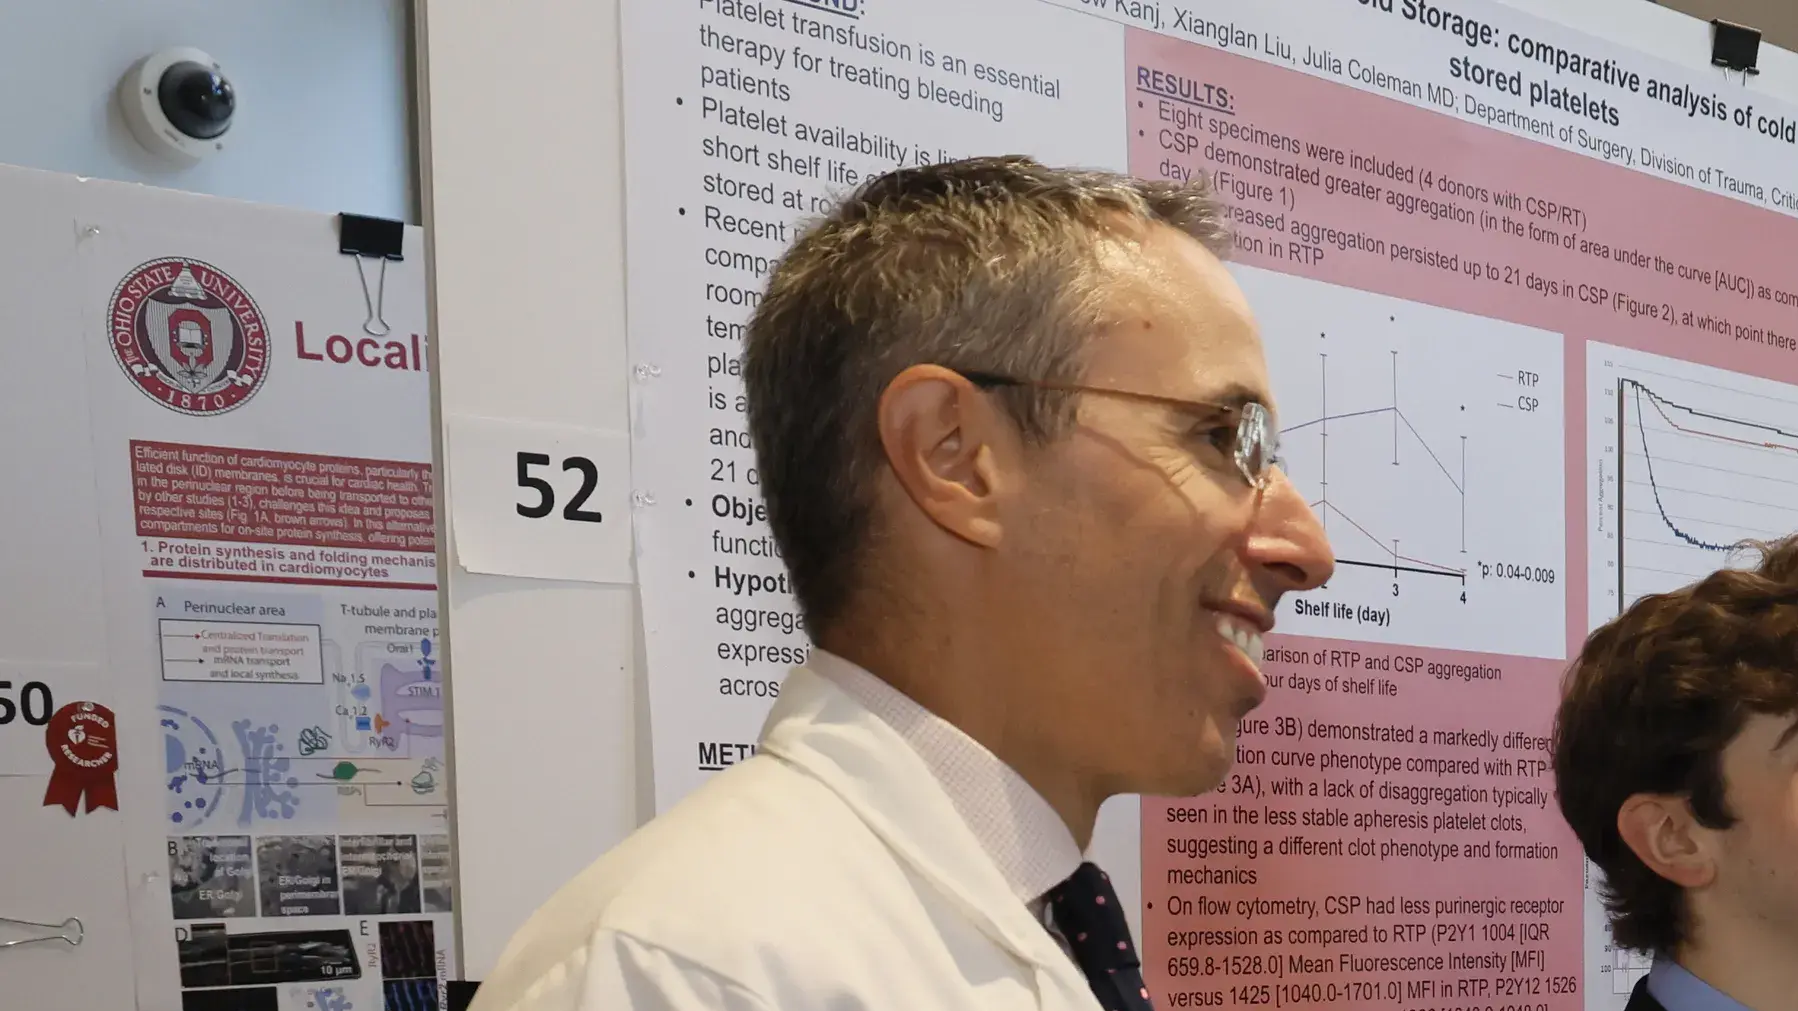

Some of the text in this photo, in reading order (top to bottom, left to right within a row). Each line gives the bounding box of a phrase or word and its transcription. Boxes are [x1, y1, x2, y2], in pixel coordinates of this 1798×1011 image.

[699, 23, 1003, 122] therapy for treating bleeding
[792, 12, 911, 62] transfusion
[919, 48, 935, 68] is
[942, 55, 967, 76] an
[974, 63, 1060, 100] essential
[1402, 0, 1500, 48] Storage:
[1508, 33, 1640, 93] comparative
[1646, 79, 1727, 121] analysis
[1733, 107, 1752, 129] of
[1757, 115, 1796, 145] cold
[701, 65, 791, 102] patients
[1137, 66, 1235, 112] RESULTS:
[1450, 57, 1619, 127] stored platelets
[1173, 7, 1257, 51] Xianglan
[1265, 34, 1296, 65] Liu,
[1302, 47, 1342, 76] Julia
[1348, 60, 1422, 100] Coleman
[1427, 83, 1459, 114] MD;
[1464, 95, 1555, 139] Department
[1559, 126, 1573, 144] of
[1577, 129, 1636, 166] Surgery,
[1641, 147, 1694, 180] Division
[1698, 168, 1711, 185] of
[1715, 170, 1767, 204] Trauma,
[702, 96, 930, 167] Platelet availability is
[702, 135, 858, 187] short shelf life
[1159, 100, 1587, 233] Eight specimens were included (4 donors with CSP/RT)
[703, 172, 804, 211] stored at
[1213, 171, 1295, 212] (Figure 1)
[705, 205, 786, 243] Recent
[128, 265, 175, 299] STATE
[114, 297, 135, 347] OHIO
[200, 271, 264, 379] UNIVERSITY
[1518, 370, 1539, 387] RTP
[166, 390, 226, 411] 1870
[1518, 395, 1539, 413] CSP
[516, 451, 602, 524] 52
[141, 540, 436, 568] 1. Protein synthesis and folding mechanis
[150, 556, 389, 579] are distributed in cardiomyocytes
[1392, 584, 1399, 597] 3
[1496, 562, 1555, 584] 0.04-0.009
[184, 600, 286, 617] Perinuclear area
[1295, 598, 1390, 627] Shelf life (day)
[1459, 591, 1467, 604] 4
[61, 744, 112, 768] RESEARCHER
[1167, 806, 1526, 834] seen in the less stable apheresis platelet clots,
[1167, 835, 1558, 862] suggesting a different clot phenotype and formation
[1167, 864, 1257, 885] mechanics
